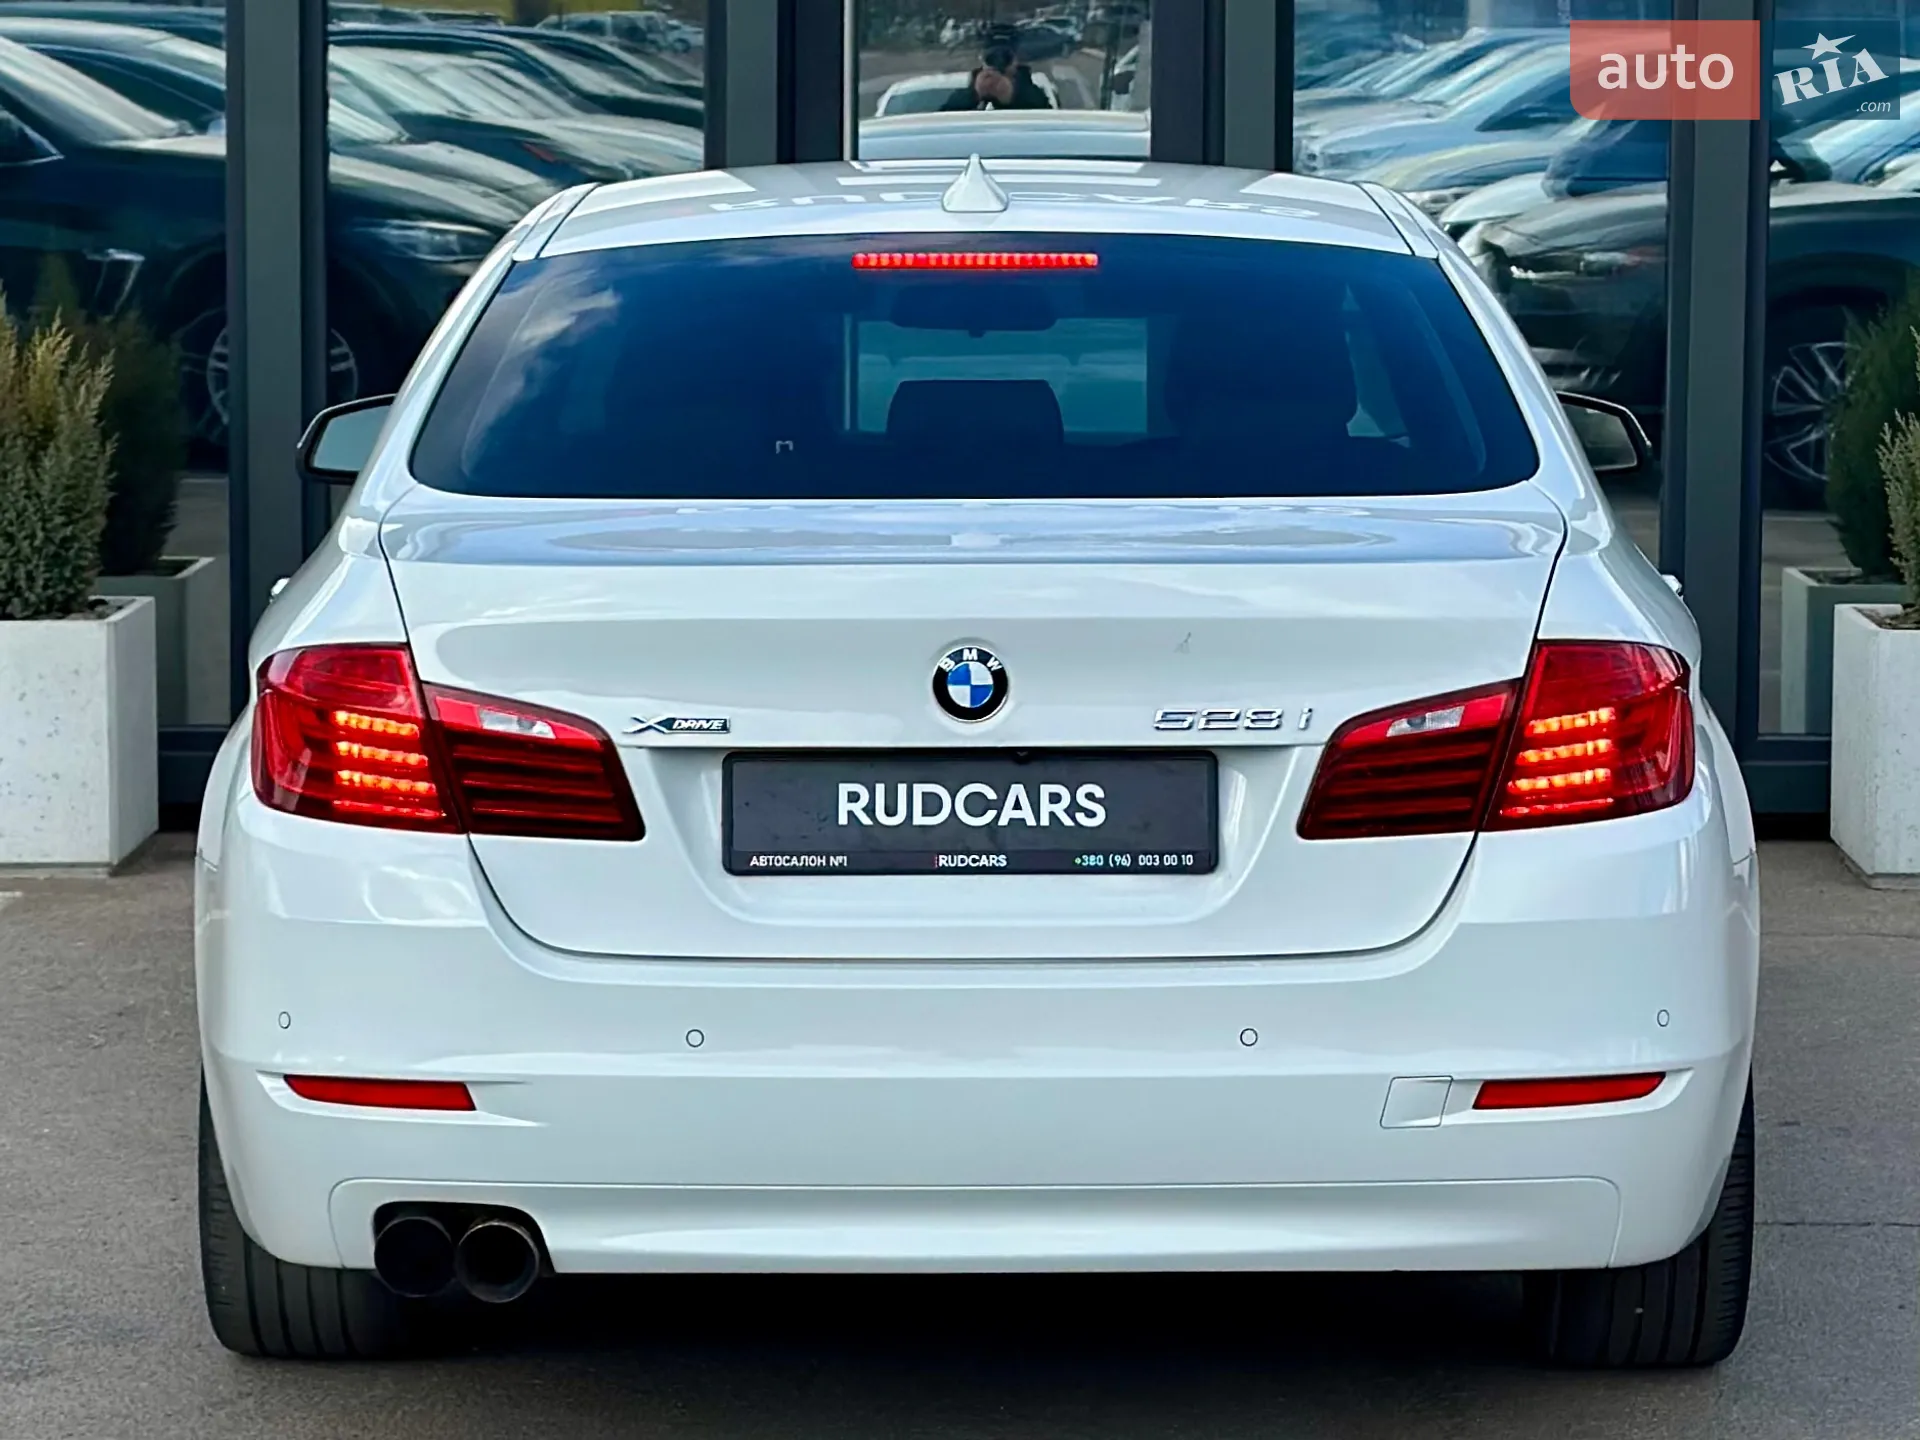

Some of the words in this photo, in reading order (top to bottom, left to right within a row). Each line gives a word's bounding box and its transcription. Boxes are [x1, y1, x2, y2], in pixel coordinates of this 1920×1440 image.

[938, 648, 1004, 673] BMW
[837, 782, 1107, 828] RUDCARS
[749, 855, 827, 867] АВТОСАЛОН
[938, 854, 1008, 867] RUDCARS
[1074, 854, 1104, 866] +380
[1108, 853, 1132, 867] (96)
[1138, 854, 1160, 866] 003
[1163, 854, 1178, 866] 00
[1181, 854, 1194, 866] 10
